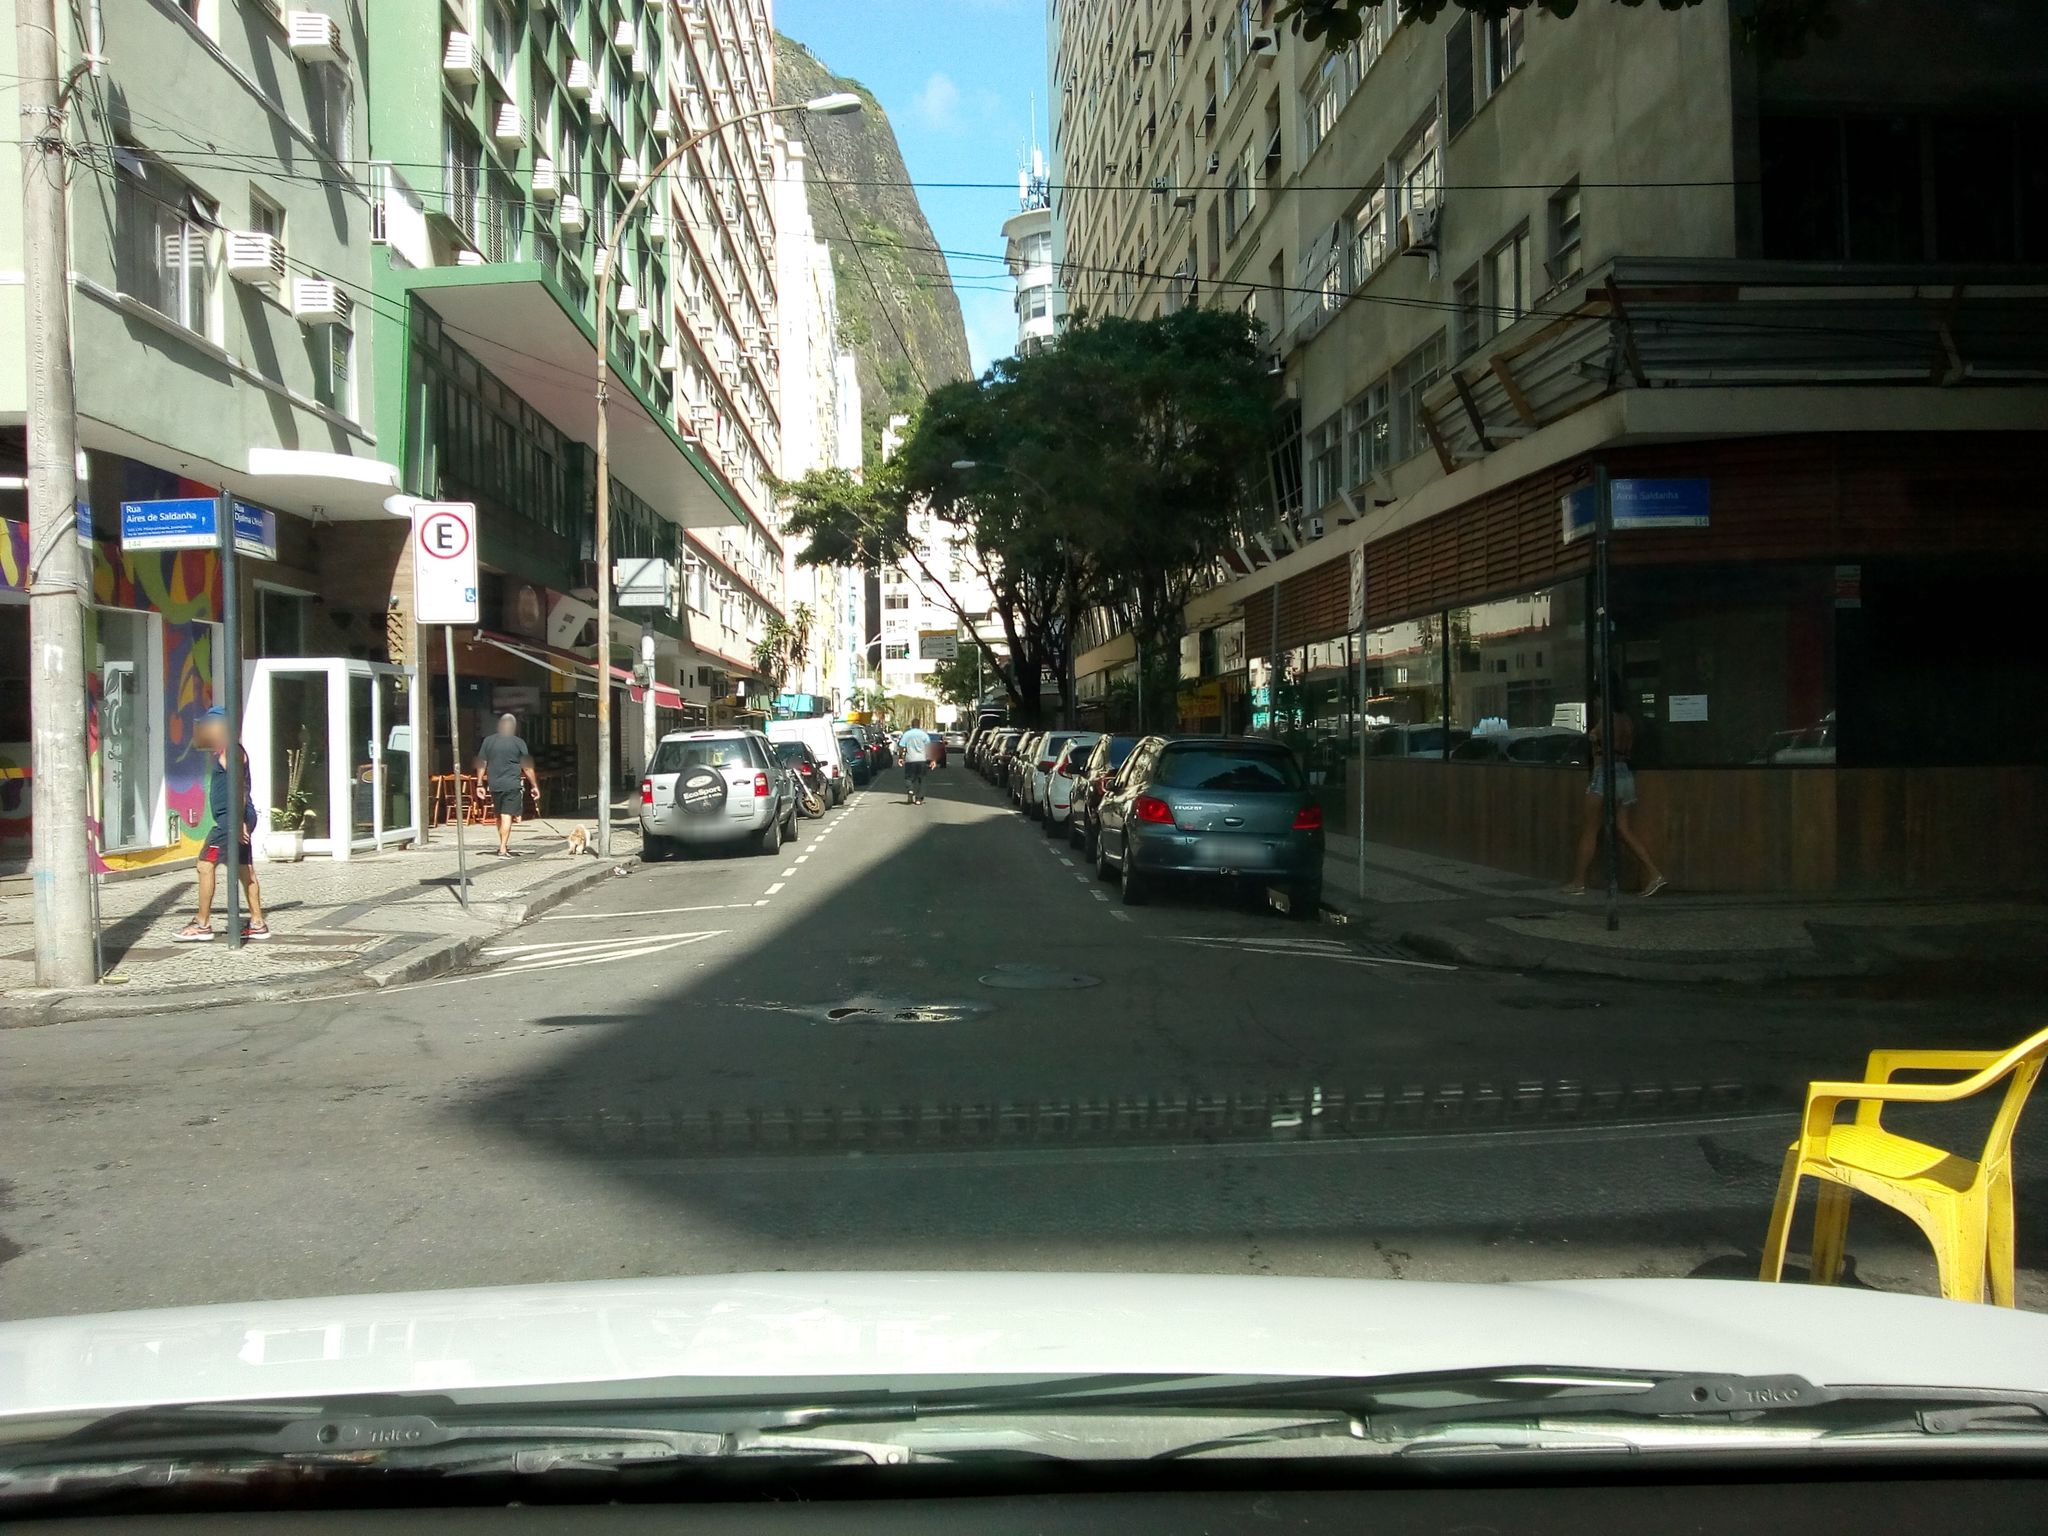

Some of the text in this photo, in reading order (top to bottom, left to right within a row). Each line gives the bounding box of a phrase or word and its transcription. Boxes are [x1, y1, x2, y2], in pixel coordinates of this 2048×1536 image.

[1616, 482, 1633, 490] Rua
[1639, 491, 1679, 500] Saldanha
[126, 505, 141, 513] Rua
[233, 503, 245, 513] Rua
[126, 511, 197, 523] Aires de Saldanha
[436, 523, 453, 549] E
[683, 785, 722, 800] EcoSport
